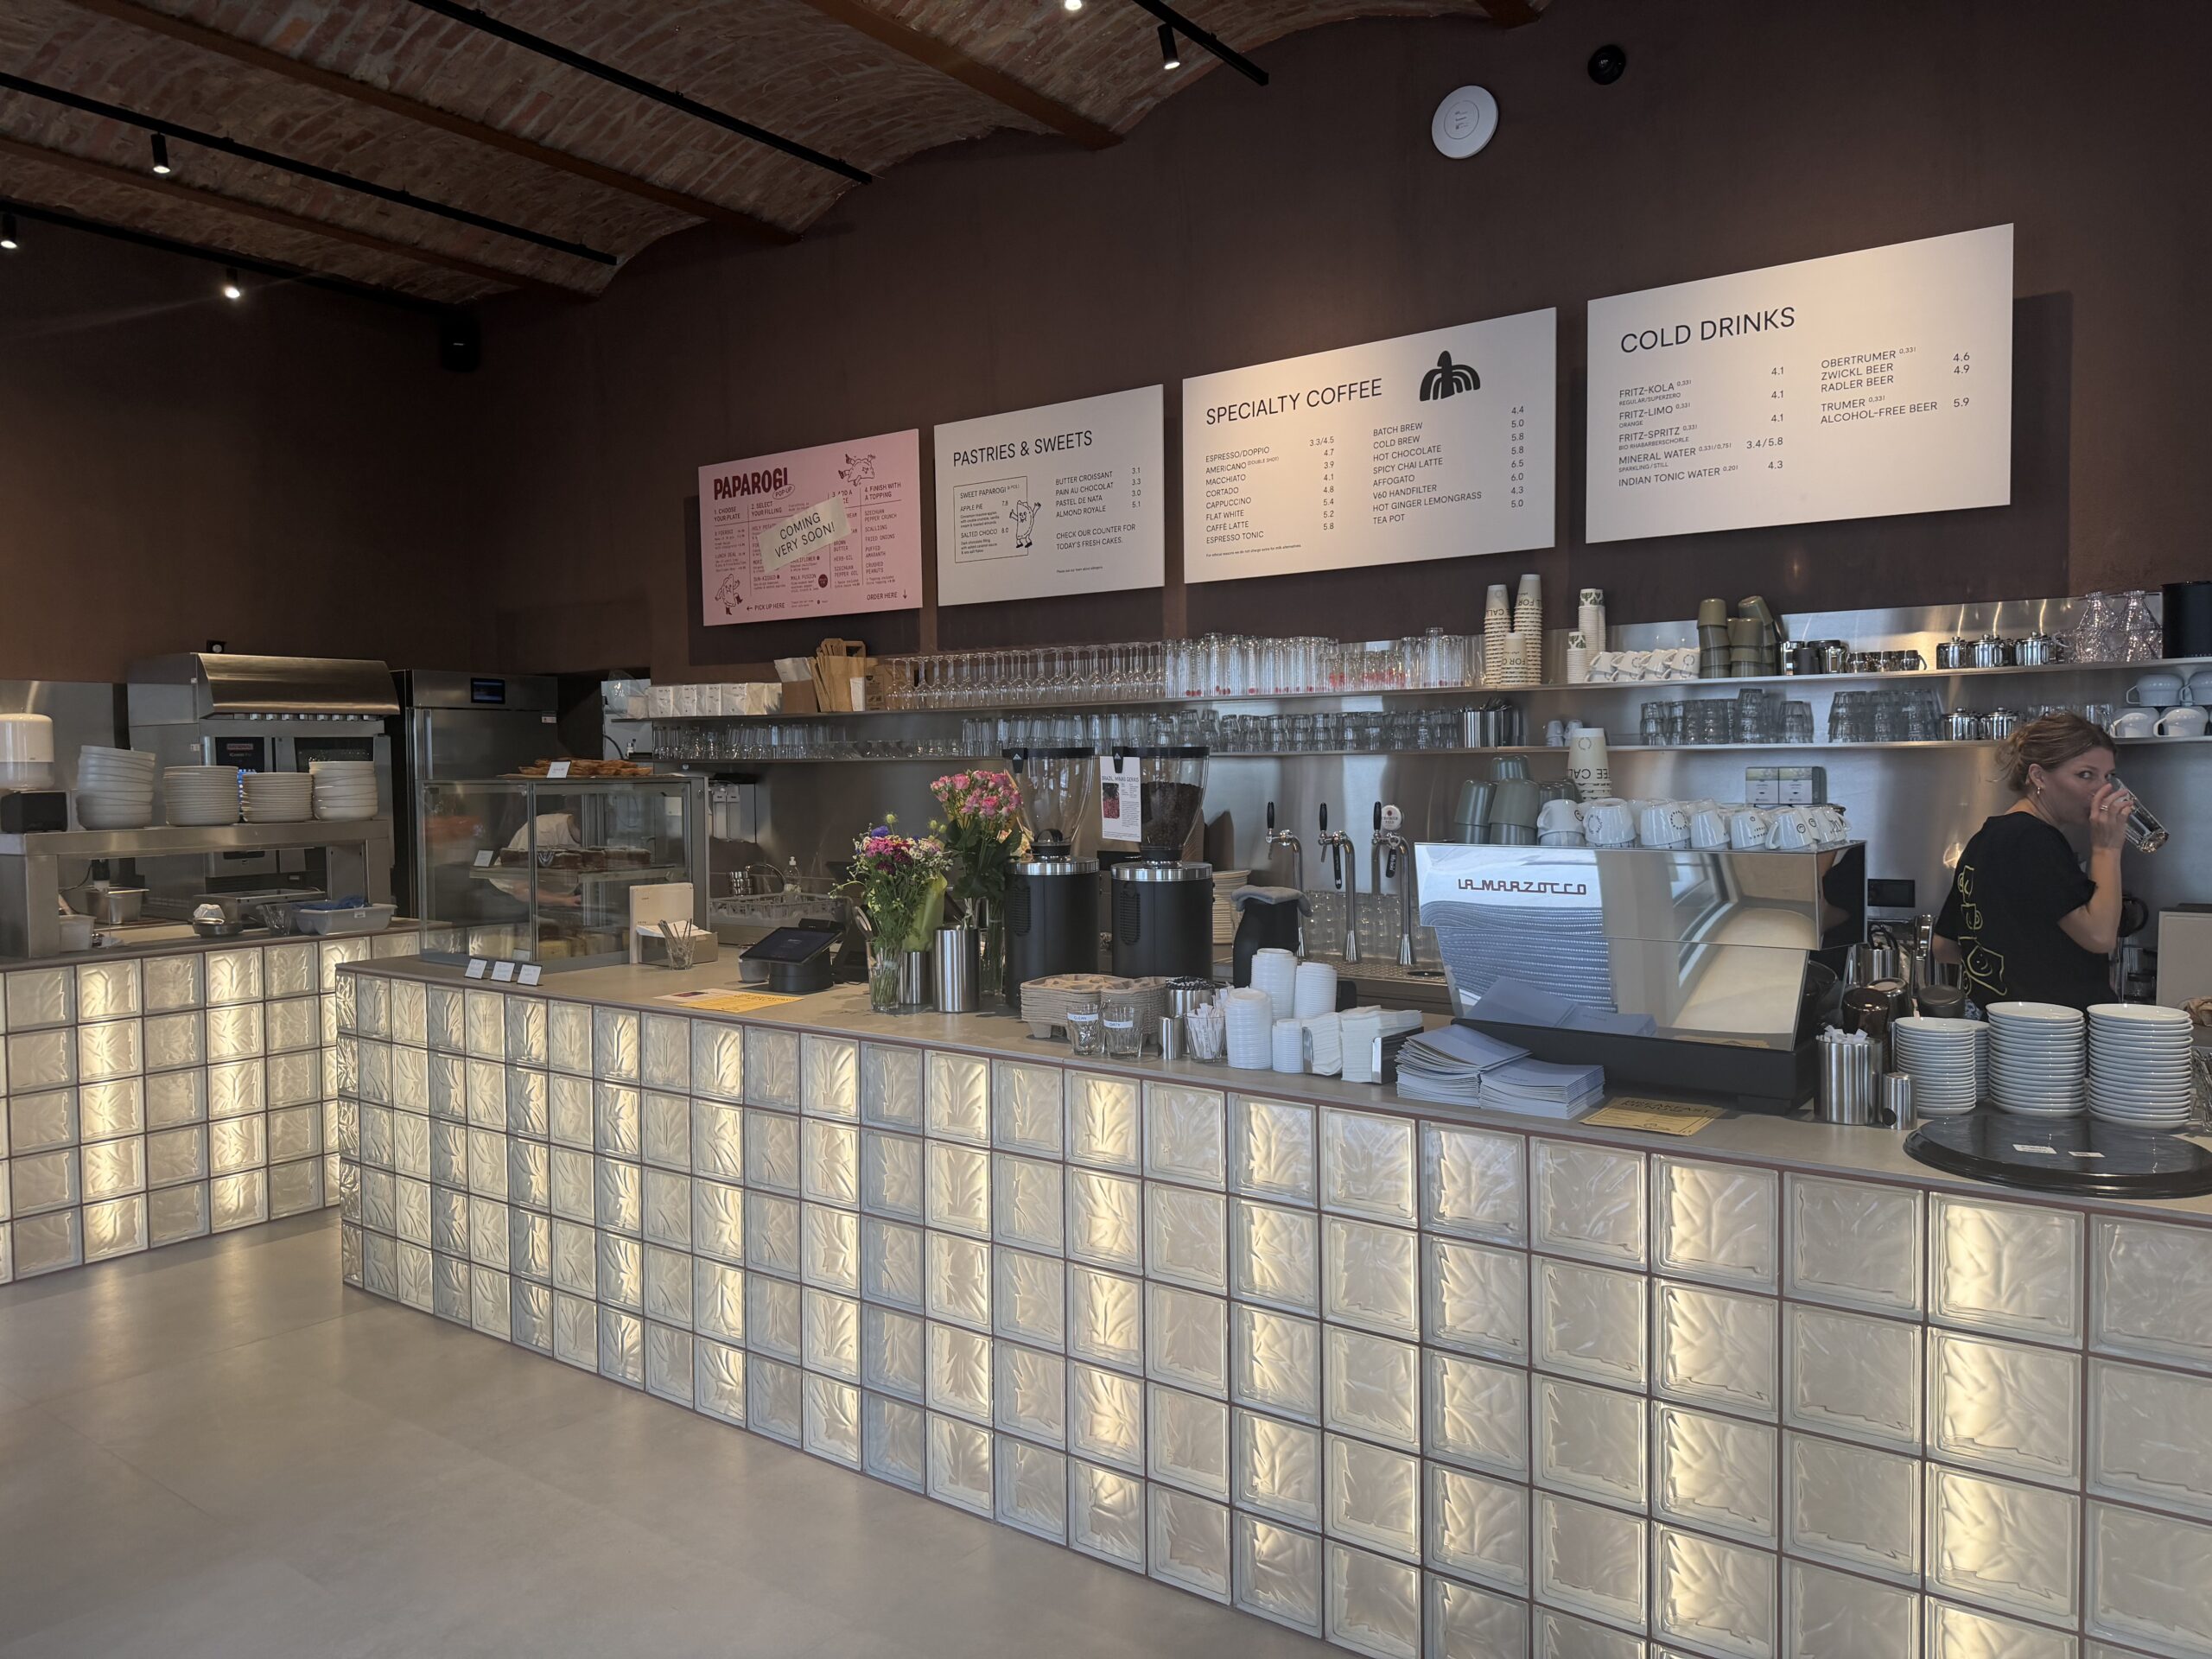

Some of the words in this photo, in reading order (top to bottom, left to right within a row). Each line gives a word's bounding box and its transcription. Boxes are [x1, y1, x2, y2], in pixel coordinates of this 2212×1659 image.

[1621, 325, 1691, 353] COLD
[1700, 307, 1795, 340] DRINKS
[1821, 350, 1896, 368] OBERTRUMER
[1953, 352, 1970, 362] 4.6
[1771, 366, 1783, 375] 4.1
[1821, 367, 1862, 380] ZWICKL
[1866, 363, 1893, 374] BEER
[1954, 365, 1970, 374] 4.9
[1619, 383, 1674, 397] FRITZ-KOLA
[1821, 379, 1862, 392] RADLER
[1866, 375, 1894, 386] BEER
[1206, 393, 1300, 425] SPECIALTY
[1306, 378, 1382, 407] COFFEE
[1619, 392, 1681, 406] REGULAR/SUPERZERO
[1821, 398, 1866, 412] TRUMER
[1954, 397, 1969, 408] 5.9
[1619, 405, 1673, 420] FRITZ-LIMO
[1821, 405, 1905, 424] ALCOHOL-FREE
[1910, 402, 1937, 413] BEER
[1373, 426, 1398, 436] BATCH
[1401, 422, 1423, 433] BREW
[1511, 419, 1524, 428] 5.0
[1310, 436, 1334, 447] 3.3/4.5
[1619, 427, 1680, 442] FRITZ-SPRITZ
[954, 443, 1015, 467] PASTRIES
[1020, 441, 1030, 456] &
[1034, 430, 1092, 454] SWEETS
[1373, 439, 1395, 449] COLD
[1398, 435, 1421, 446] BREW
[1206, 447, 1269, 462] ESPRESSO/DOPPIO
[1373, 453, 1389, 461] HOT
[1392, 445, 1441, 458] CHOCOLATE
[1511, 446, 1524, 454] 5.8
[1619, 452, 1661, 465] MINERAL
[1664, 448, 1696, 459] WATER
[1206, 462, 1246, 474] AMERICANO
[1373, 465, 1395, 474] SPICY
[1398, 461, 1417, 471] CHAI
[1419, 458, 1443, 467] LATTE
[1511, 460, 1524, 468] 6.5
[1768, 461, 1783, 469] 4.3
[714, 467, 787, 500] PAPAROGI
[1056, 476, 1077, 485] BUTTER
[1079, 471, 1112, 482] CROISSANT
[1206, 474, 1246, 486] MACCHIATO
[1373, 474, 1414, 487] AFFOGATO
[1511, 473, 1523, 481] 6.0
[1618, 476, 1651, 486] INDIAN
[1655, 472, 1685, 483] TONIC
[1688, 467, 1720, 479] WATER
[775, 486, 792, 497] POP-UP
[979, 487, 1006, 496] PAPAROGI
[1080, 482, 1113, 493] CHOCOLAT
[1206, 487, 1239, 498] CORTADO
[1373, 491, 1387, 499] V60
[1389, 485, 1437, 497] HANDFILTER
[1206, 497, 1251, 509] CAPPUCCINO
[1373, 504, 1389, 512] HOT
[1391, 499, 1421, 510] GINGER
[1424, 492, 1482, 505] LEMONGRASS
[1511, 499, 1523, 508] 5.0
[1057, 509, 1082, 518] ALMOND
[1084, 505, 1106, 514] ROYALE
[1206, 512, 1222, 521] FLAT
[1224, 510, 1244, 518] WHITE
[780, 512, 821, 539] COMING
[1229, 521, 1249, 530] LATTE
[1373, 516, 1387, 524] TEA
[1389, 514, 1405, 523] POT
[1057, 531, 1077, 539] CHECK
[1092, 525, 1121, 535] COUNTER
[1206, 533, 1241, 544] ESPRESSO
[1243, 531, 1264, 540] TONIC
[775, 538, 798, 558] VERY
[802, 521, 835, 545] SOON!
[1459, 879, 1473, 890] LA
[1482, 880, 1586, 895] MARZOCCO
